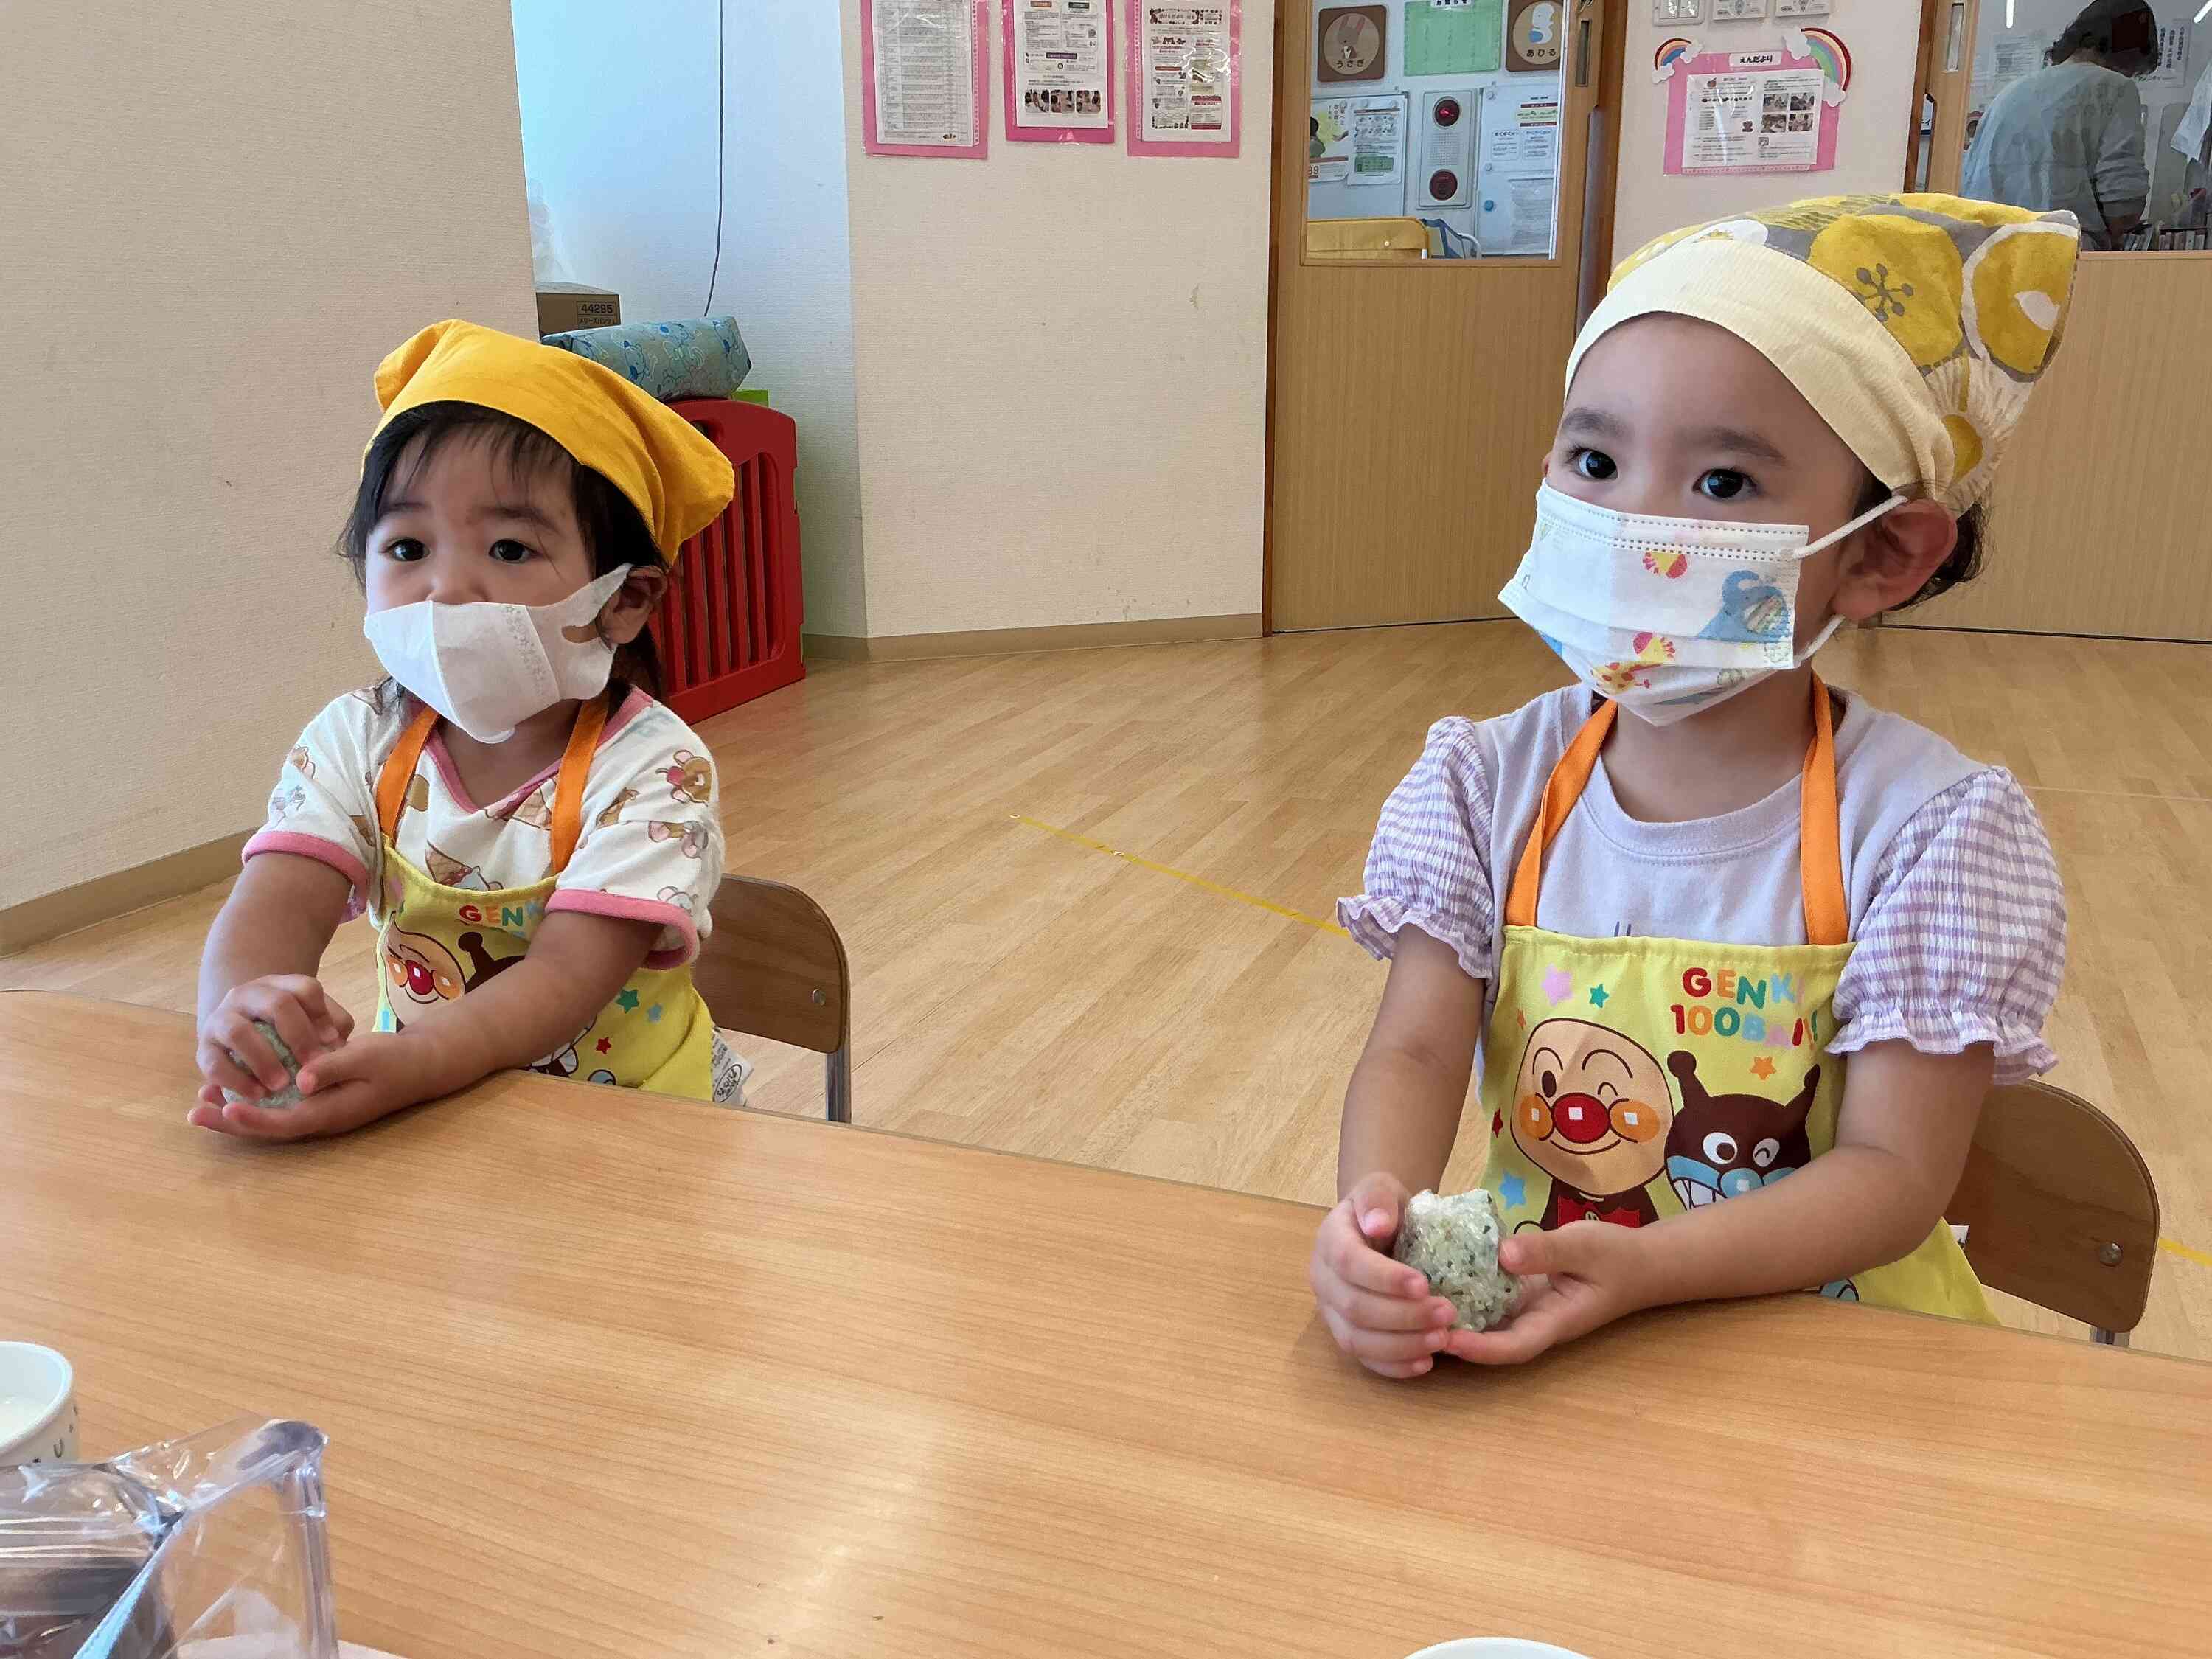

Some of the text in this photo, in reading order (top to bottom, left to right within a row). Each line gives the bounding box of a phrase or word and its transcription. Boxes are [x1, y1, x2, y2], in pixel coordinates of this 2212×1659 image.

[1526, 48, 1556, 58] あひる
[1336, 59, 1364, 69] うさぎ
[1739, 55, 1773, 63] えんだより
